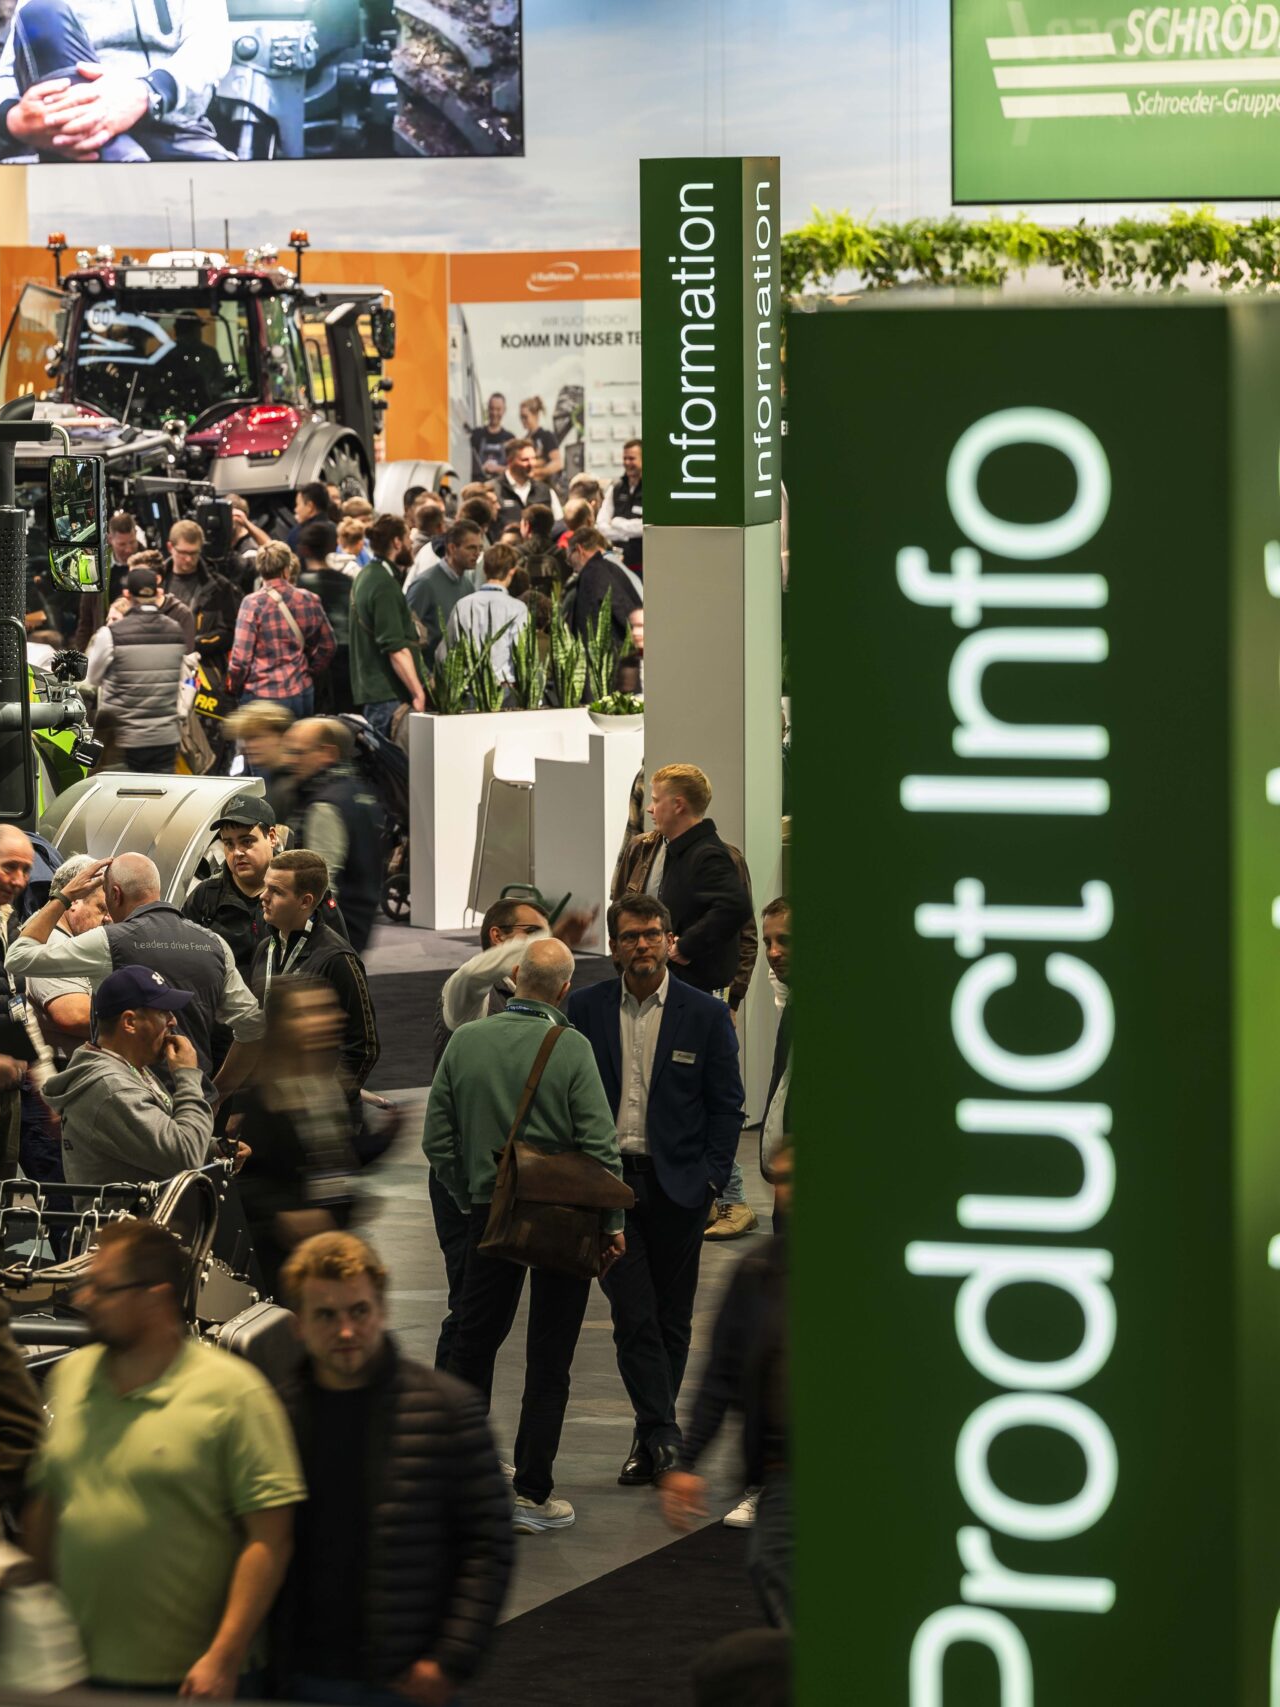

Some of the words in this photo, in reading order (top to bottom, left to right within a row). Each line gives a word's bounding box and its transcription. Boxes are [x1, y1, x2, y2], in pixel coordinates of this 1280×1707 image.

[1124, 0, 1280, 56] SCHRÖD
[501, 334, 550, 348] KOMM
[554, 333, 570, 347] IN
[574, 331, 623, 346] UNSER
[627, 331, 642, 345] TE
[668, 182, 717, 500] Information
[752, 181, 772, 498] Information
[895, 405, 1113, 816] Info
[133, 940, 168, 950] Leaders
[170, 940, 189, 950] drive
[903, 876, 1120, 1707] Product
